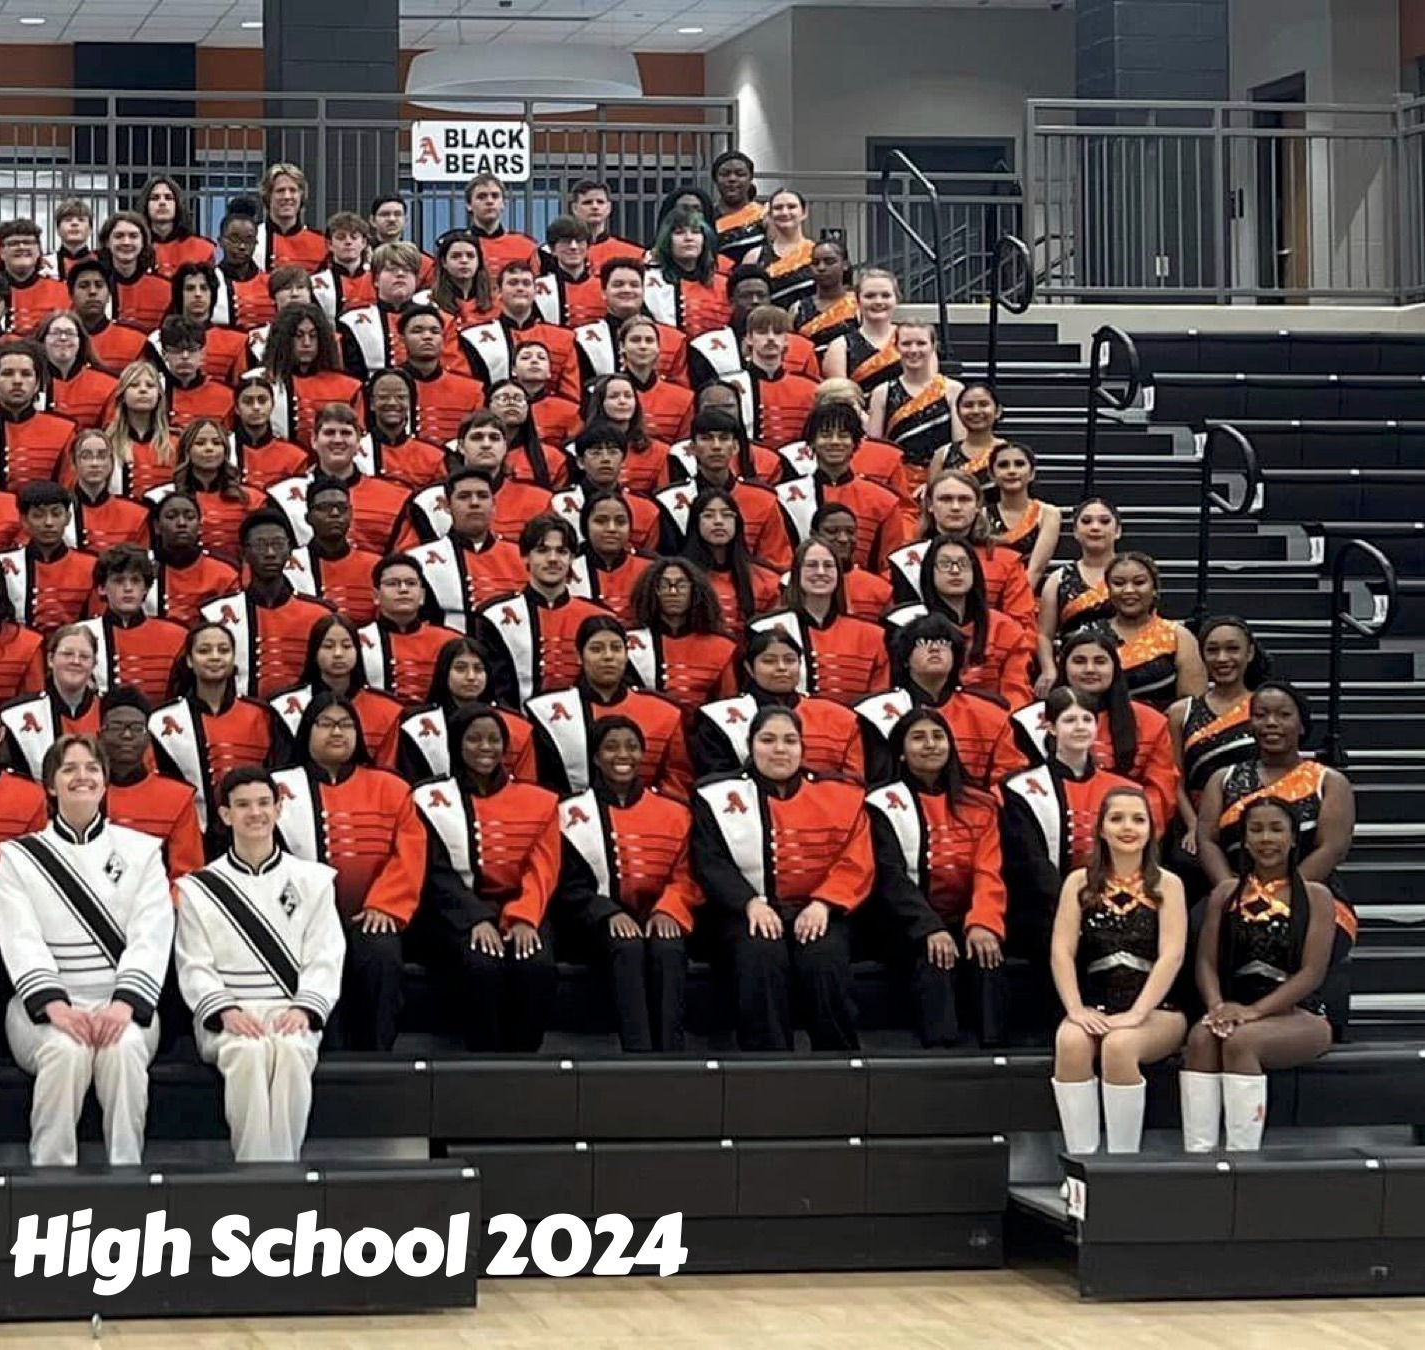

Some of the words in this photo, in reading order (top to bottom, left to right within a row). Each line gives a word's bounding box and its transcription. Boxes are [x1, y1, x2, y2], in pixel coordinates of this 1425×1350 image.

[444, 128, 525, 150] BLACK
[415, 136, 441, 166] A
[445, 153, 525, 175] BEARS
[786, 486, 807, 502] A
[425, 550, 446, 565] A
[500, 606, 522, 626] A
[20, 712, 43, 734] A
[548, 702, 573, 724] A
[726, 707, 748, 724] A
[161, 716, 183, 737] A
[419, 718, 441, 737] A
[1026, 778, 1048, 797] A
[428, 790, 451, 808] A
[723, 791, 748, 814] A
[885, 791, 908, 811] A
[566, 806, 590, 827] A
